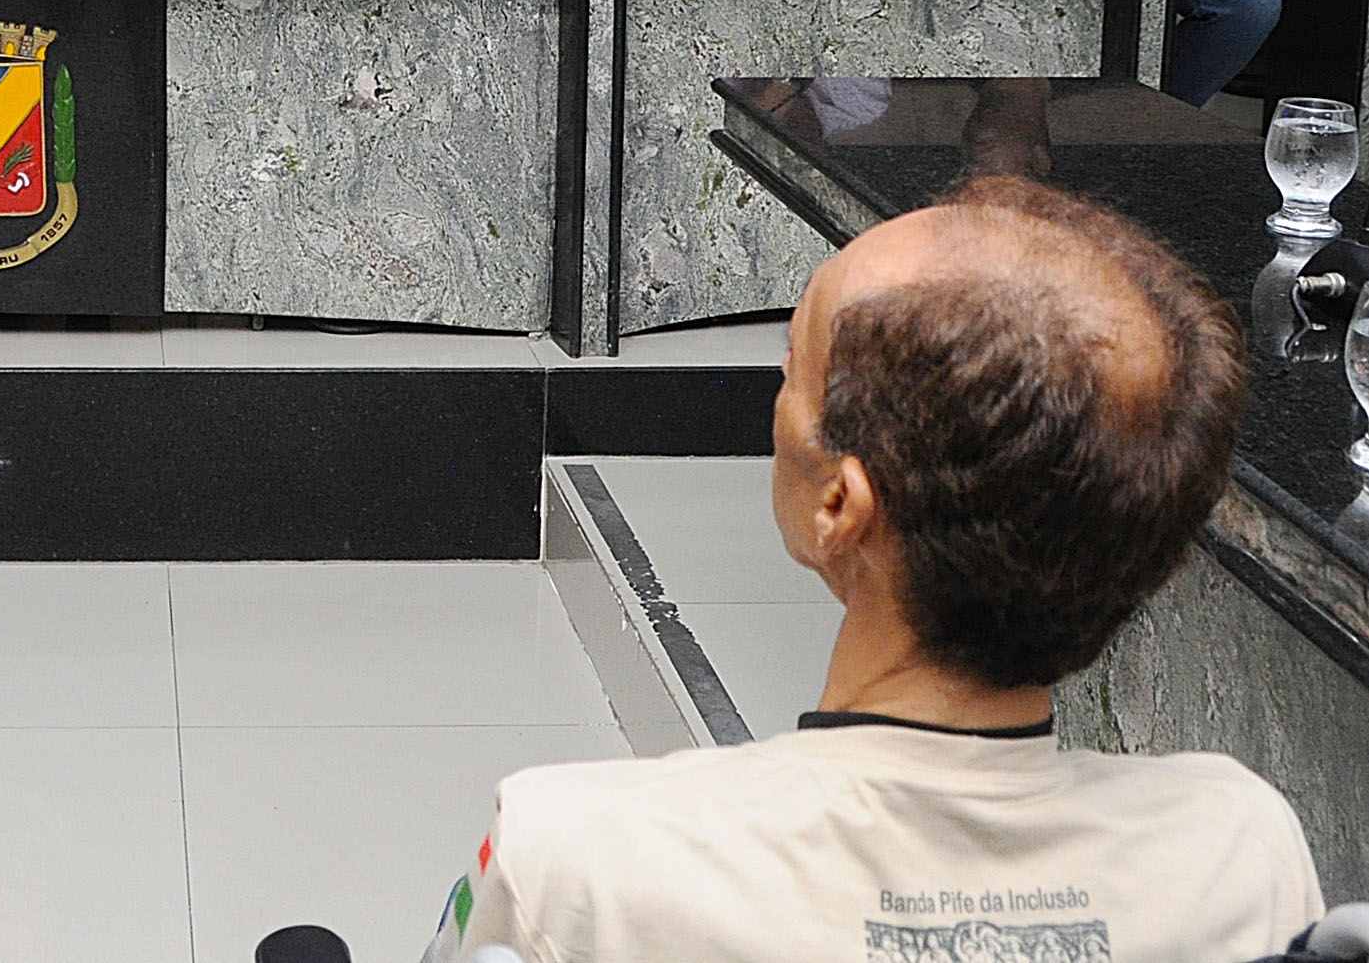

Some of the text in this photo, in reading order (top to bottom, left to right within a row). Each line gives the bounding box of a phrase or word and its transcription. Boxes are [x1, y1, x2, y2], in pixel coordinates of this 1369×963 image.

[881, 886, 1090, 914] Banda Pife da Inclusão
